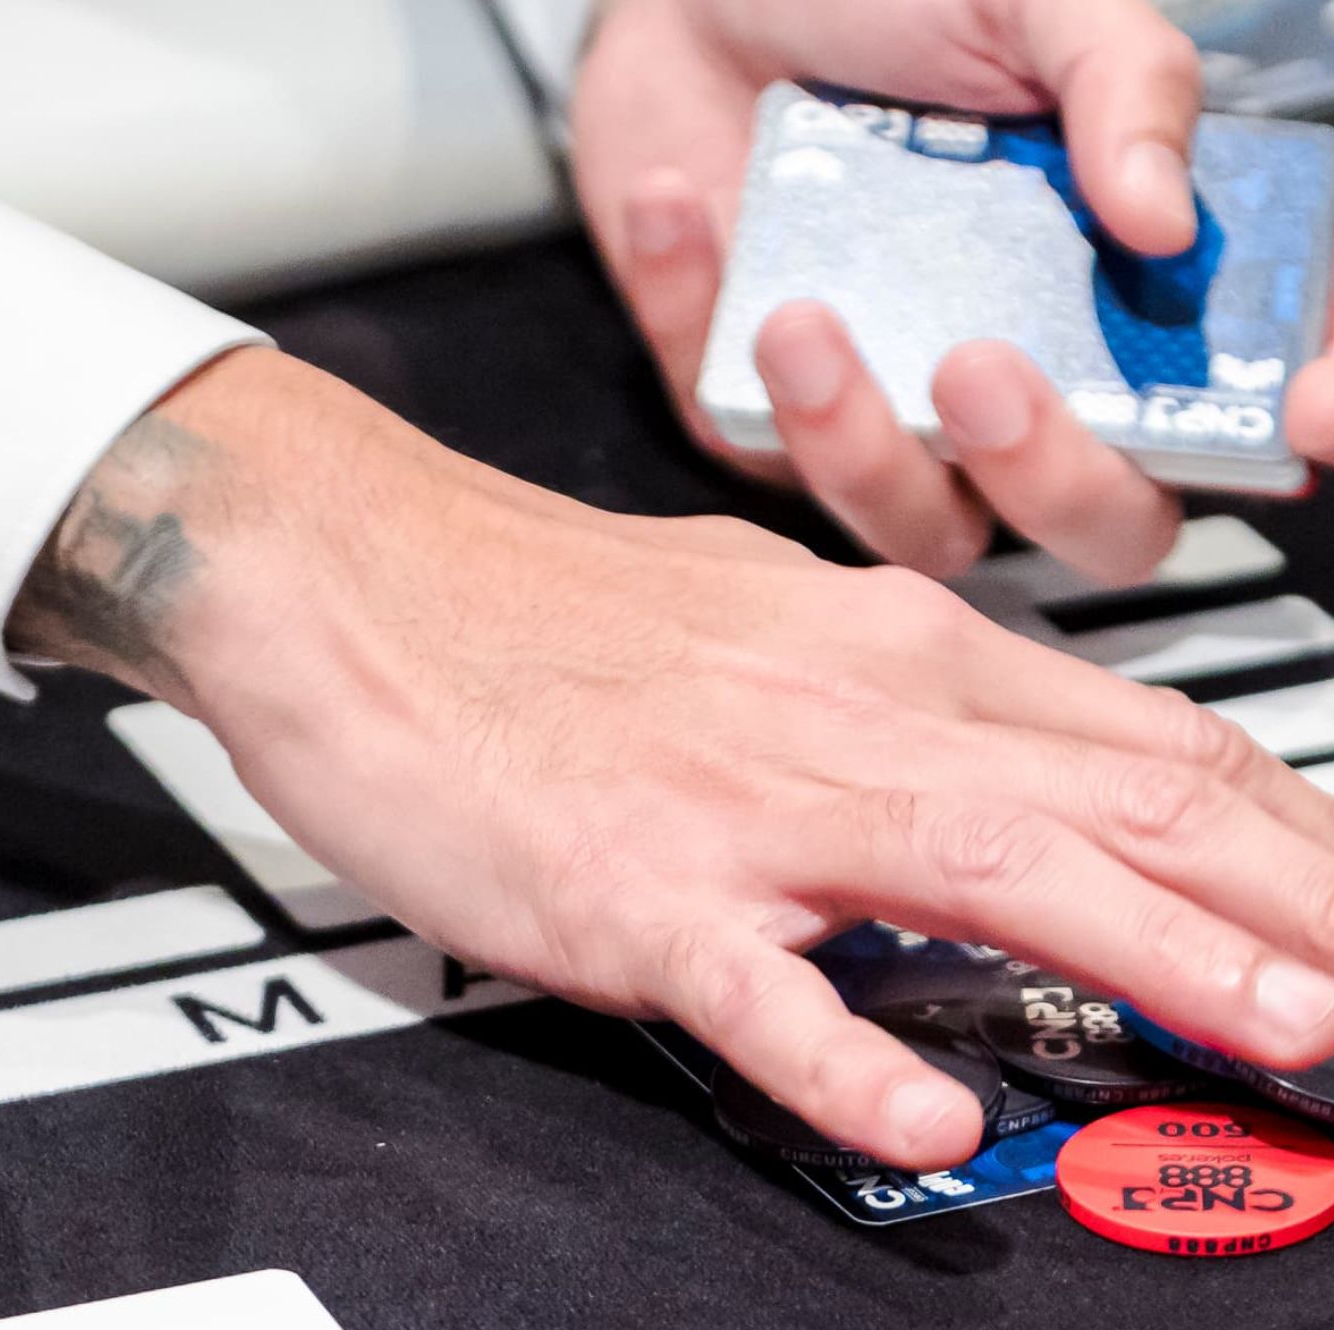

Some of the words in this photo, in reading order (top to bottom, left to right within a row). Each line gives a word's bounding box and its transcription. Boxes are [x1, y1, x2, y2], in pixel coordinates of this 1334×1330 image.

[1158, 1121, 1252, 1138] 500
[1158, 1153, 1252, 1164] poker.es
[1158, 1164, 1253, 1189] 888
[1167, 1234, 1272, 1255] CNP888
